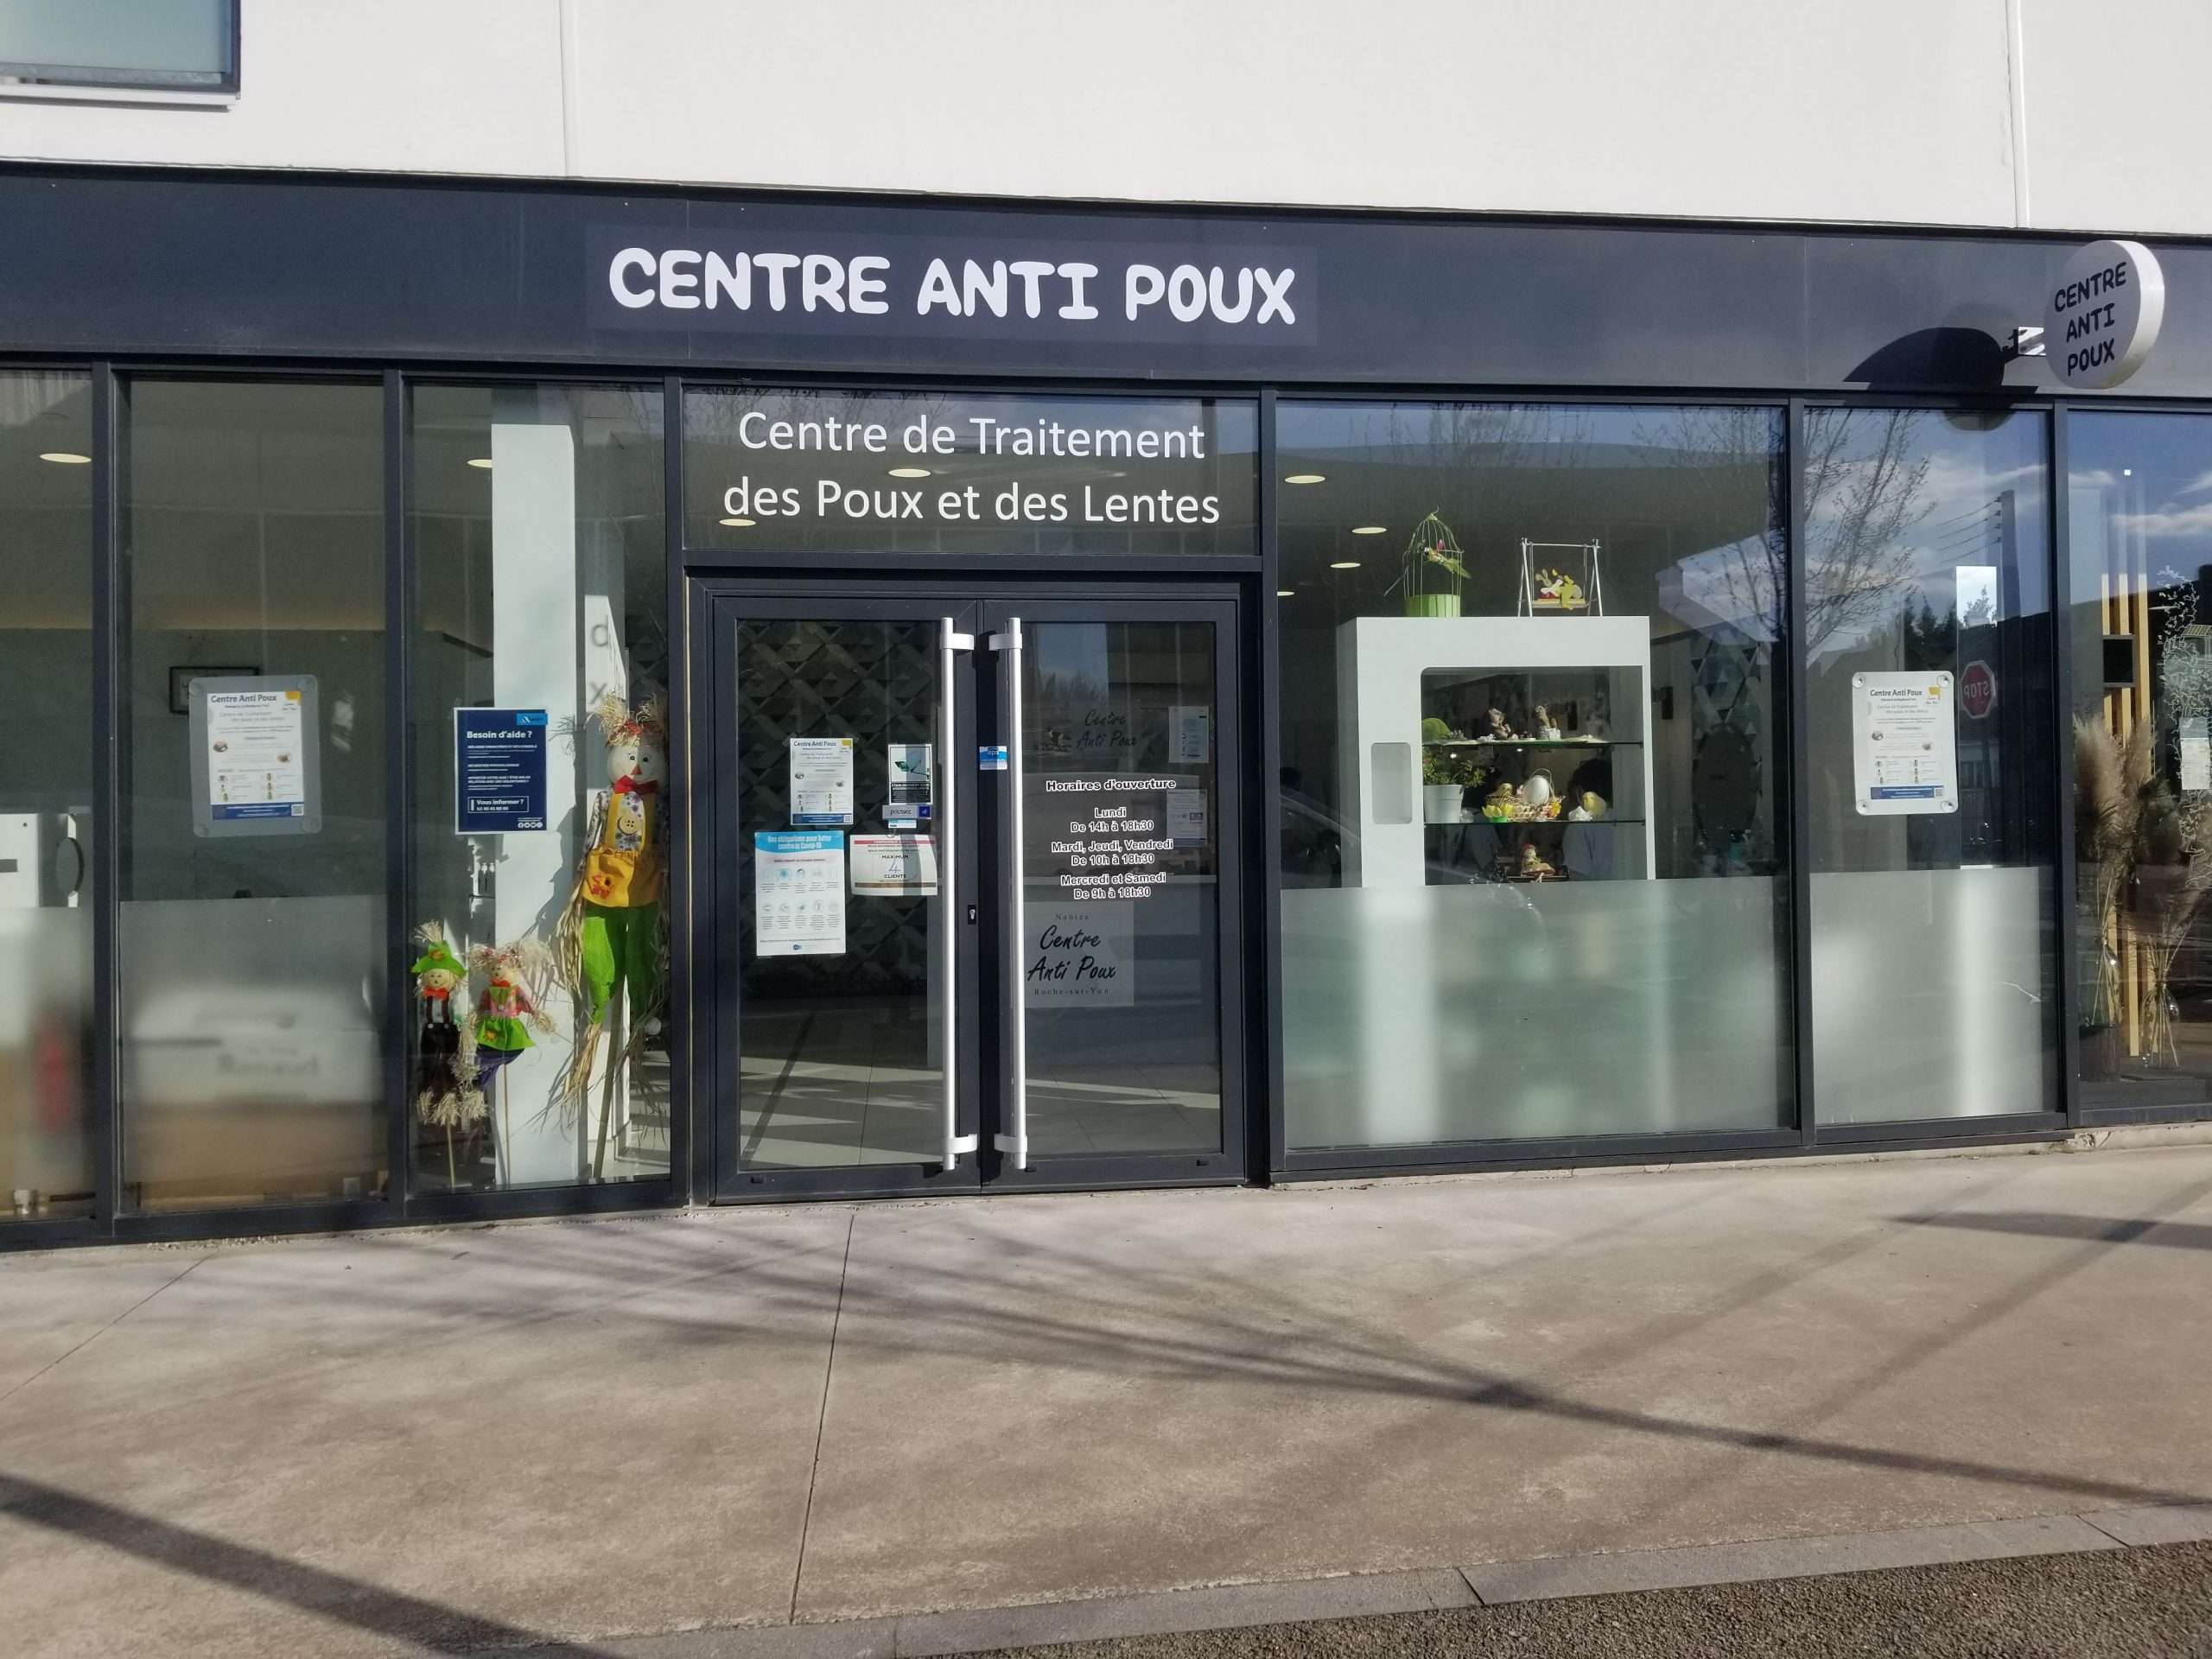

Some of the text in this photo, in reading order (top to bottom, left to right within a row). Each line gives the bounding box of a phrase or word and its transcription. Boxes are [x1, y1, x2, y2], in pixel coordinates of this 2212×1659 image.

[609, 247, 1296, 325] CENTRE ANTI POUX
[2054, 261, 2127, 313] CENTRE
[2066, 302, 2115, 343] ANTI
[2068, 338, 2115, 377] POUX
[739, 411, 1205, 459] Centre de Traitement
[722, 475, 1219, 524] des Poux et des Lentes
[211, 695, 238, 703] Centre
[238, 694, 257, 702] Anti
[1046, 779, 1176, 791] Horaires d'ouverture
[1094, 807, 1127, 818] Lundi
[1070, 820, 1154, 833] De 14h à 18h30
[1051, 839, 1174, 853] Mardi, Jeudi, Vendredi
[1071, 854, 1154, 867] De 10h à 18h30
[1060, 872, 1166, 887] Mercredi et Samedi
[1073, 888, 1090, 899] De
[1091, 887, 1106, 899] 9h
[1117, 887, 1151, 898] 18h30
[1039, 924, 1101, 950] Centre
[1027, 955, 1116, 982] Anti Poux
